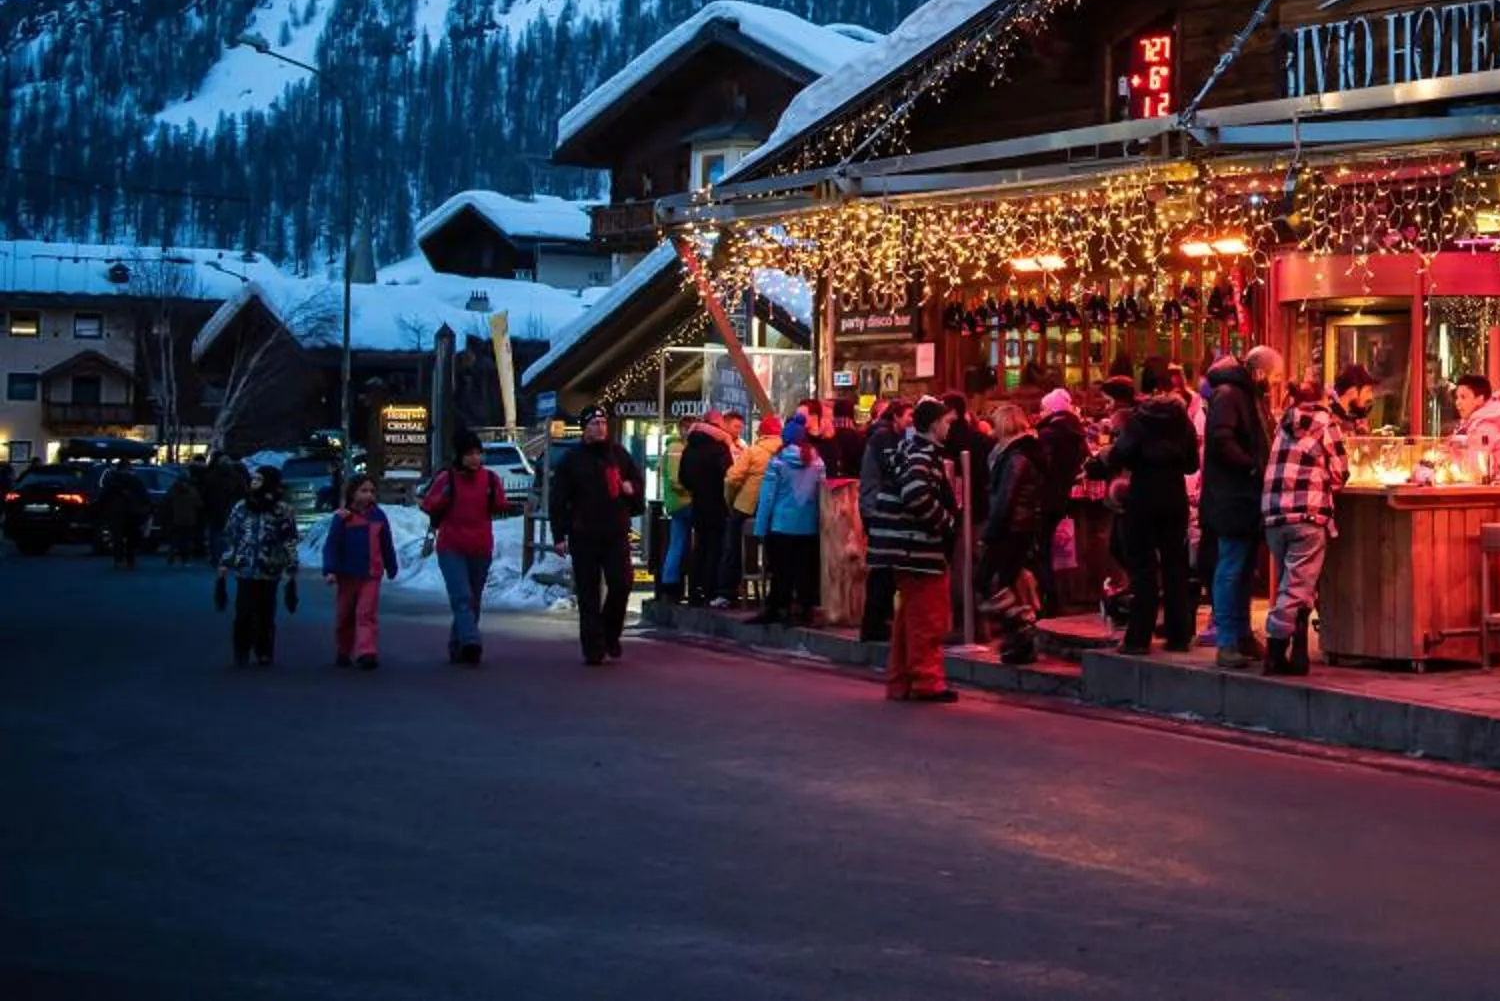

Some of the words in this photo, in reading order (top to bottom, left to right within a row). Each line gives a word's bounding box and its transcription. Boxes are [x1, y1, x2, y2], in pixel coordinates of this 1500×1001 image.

[841, 318, 865, 332] party
[866, 315, 893, 328] disco
[894, 313, 912, 326] bar
